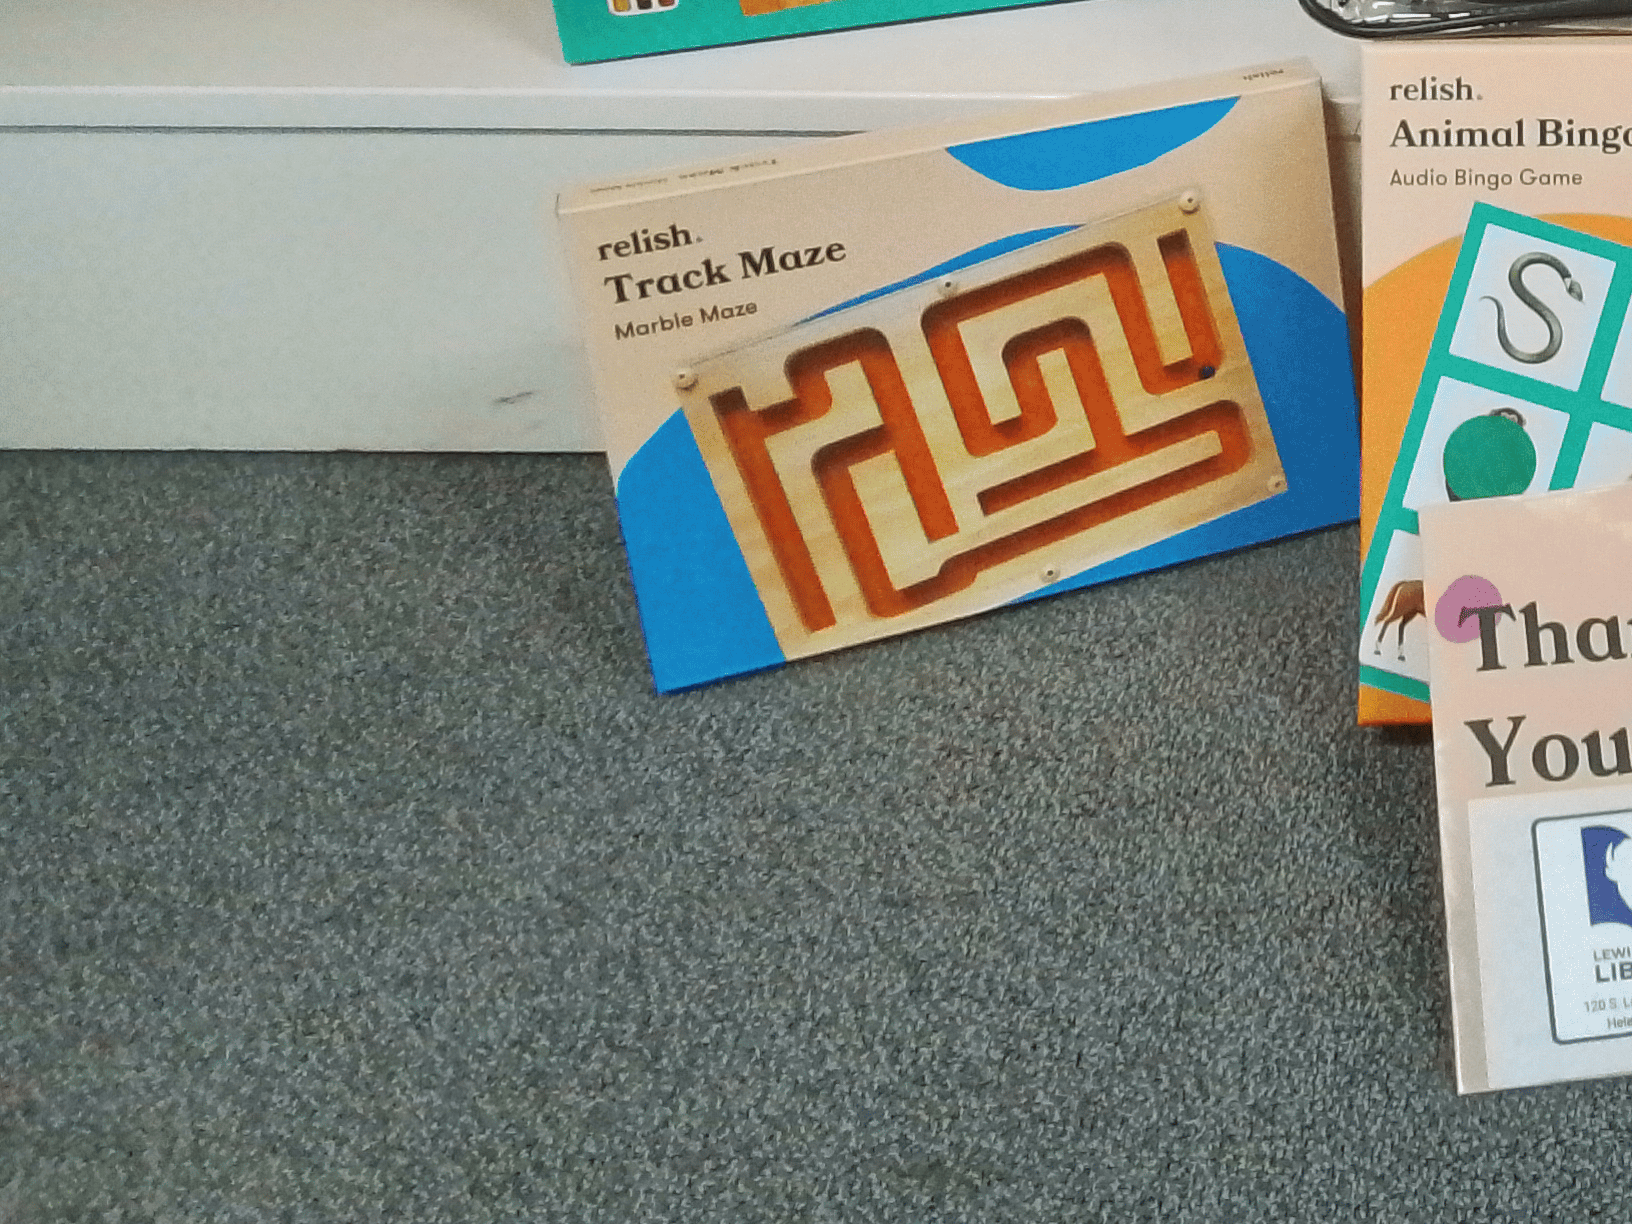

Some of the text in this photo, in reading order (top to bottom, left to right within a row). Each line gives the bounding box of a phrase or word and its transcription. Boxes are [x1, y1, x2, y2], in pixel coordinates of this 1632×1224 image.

[1389, 118, 1526, 148] Animal
[1389, 167, 1584, 191] Audio Bingo Game
[603, 241, 847, 305] Track Maze
[614, 301, 758, 341] Marble Maze
[1584, 998, 1606, 1013] 120
